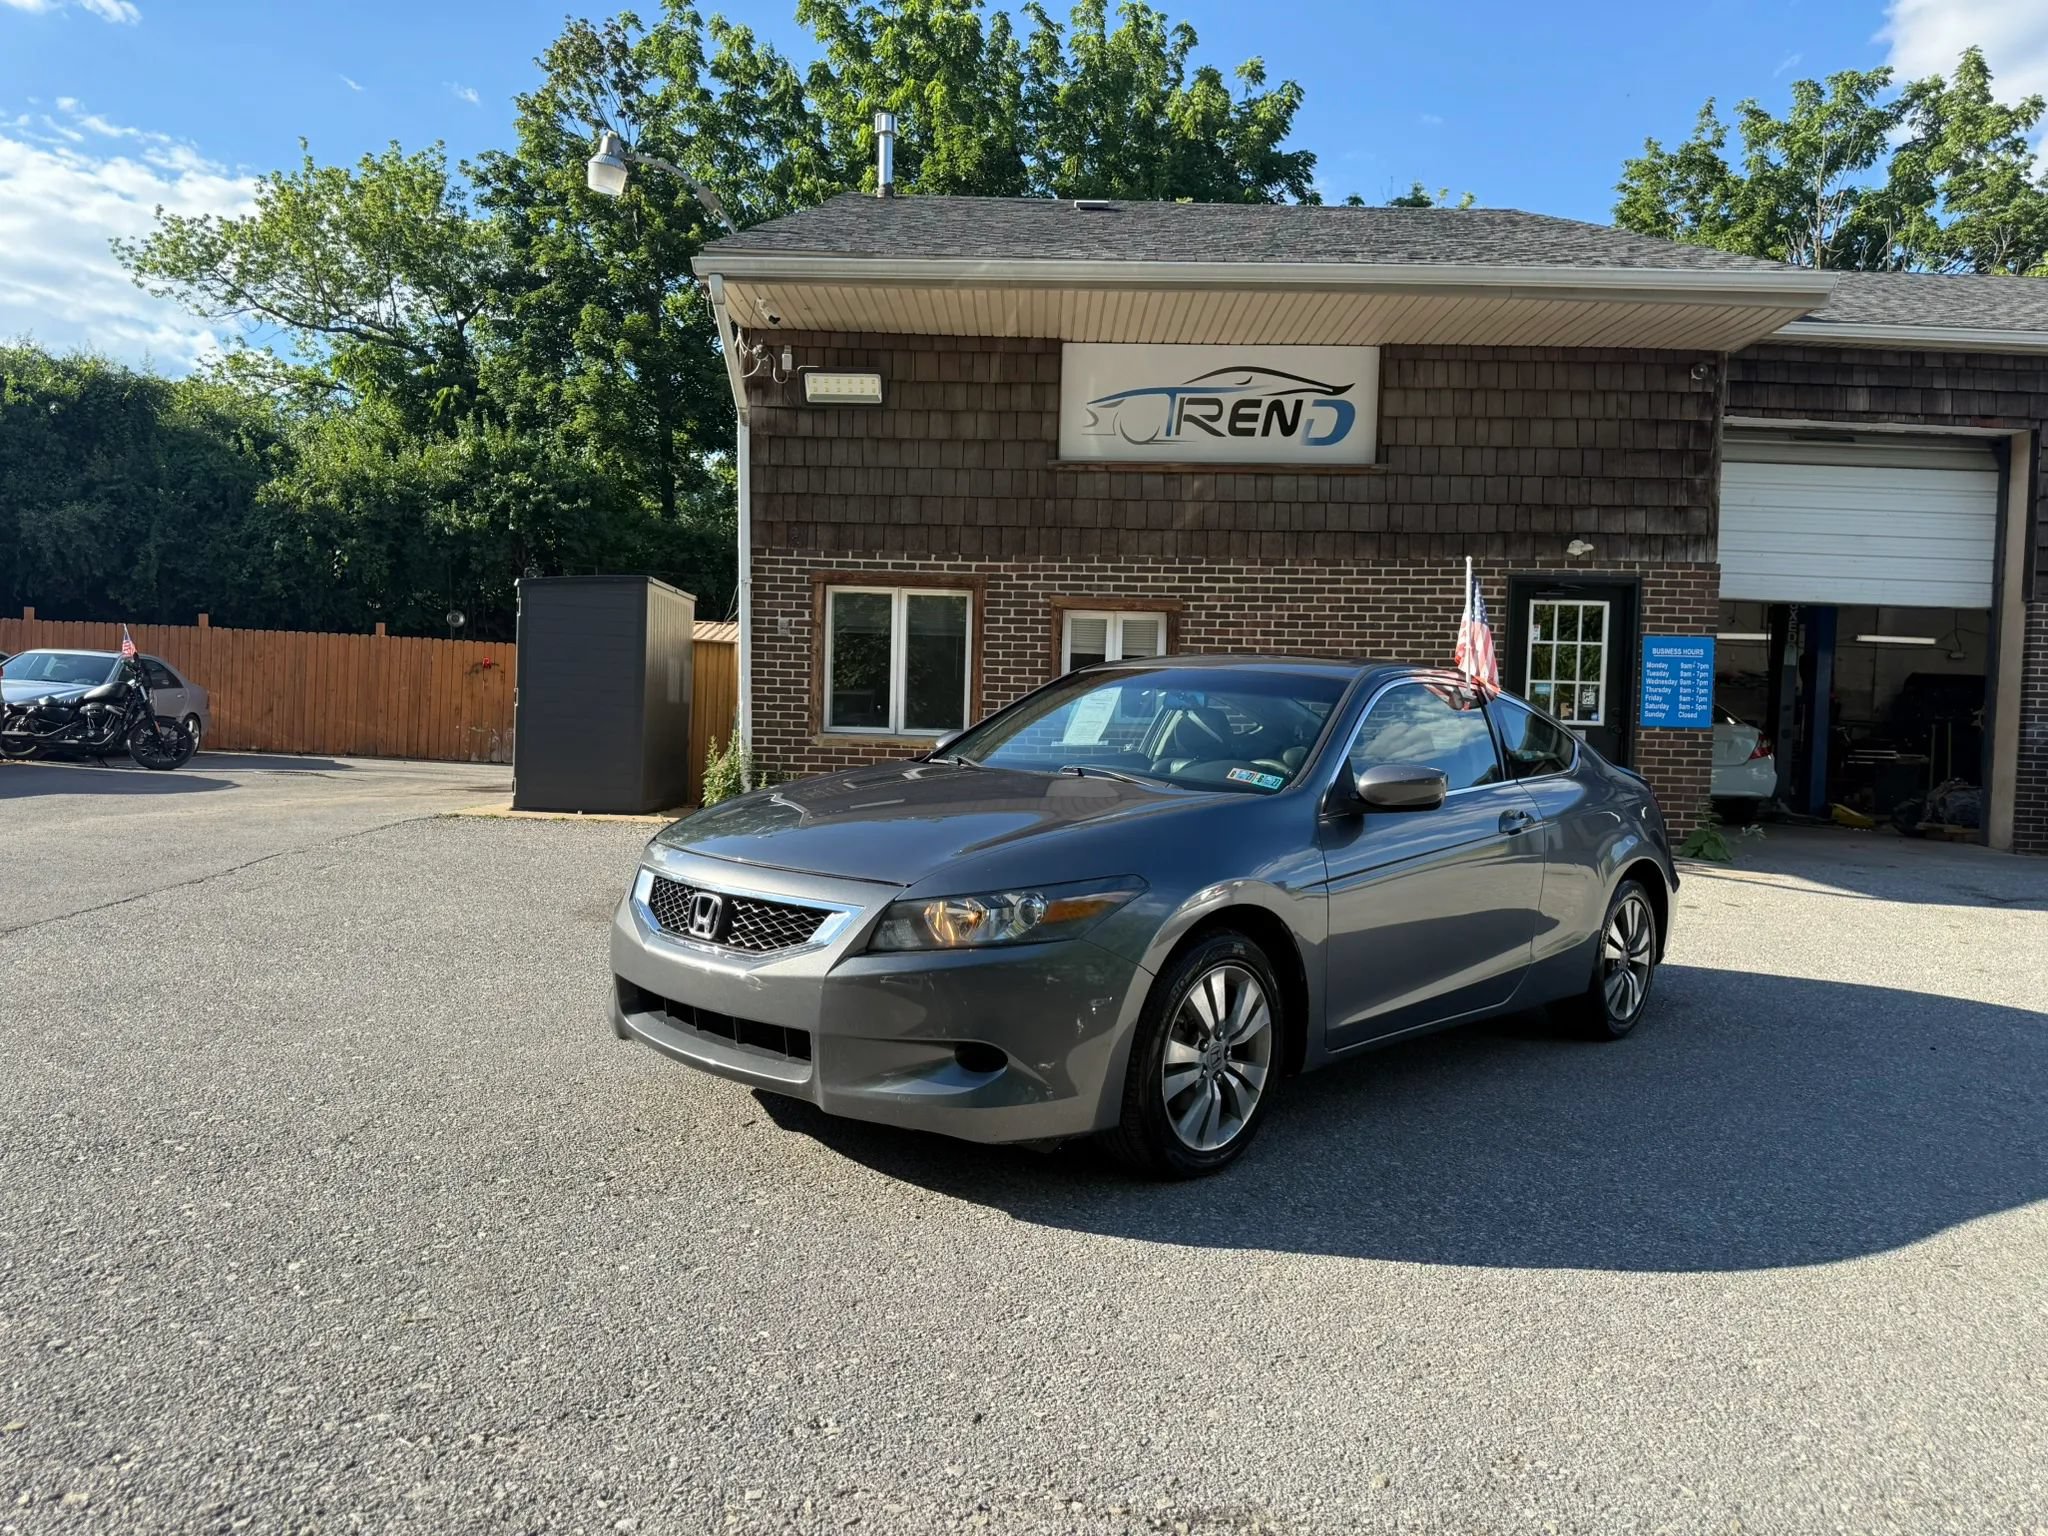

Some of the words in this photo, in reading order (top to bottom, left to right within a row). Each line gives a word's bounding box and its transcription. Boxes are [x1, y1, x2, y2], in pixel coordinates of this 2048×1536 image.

[1156, 386, 1356, 446] TREND
[1682, 648, 1704, 656] HOURS
[1646, 661, 1668, 669] Monday
[1697, 662, 1710, 670] 7pm
[1646, 670, 1670, 678] Tuesday
[1645, 678, 1678, 686] Wednesday
[1696, 679, 1708, 687] 7pm
[1645, 686, 1671, 695] Thursday
[1696, 687, 1708, 695] 7pm
[1645, 694, 1662, 702] Friday
[1695, 695, 1708, 703] 7pm
[1645, 703, 1669, 711] Saturday
[1644, 711, 1666, 719] Sunday
